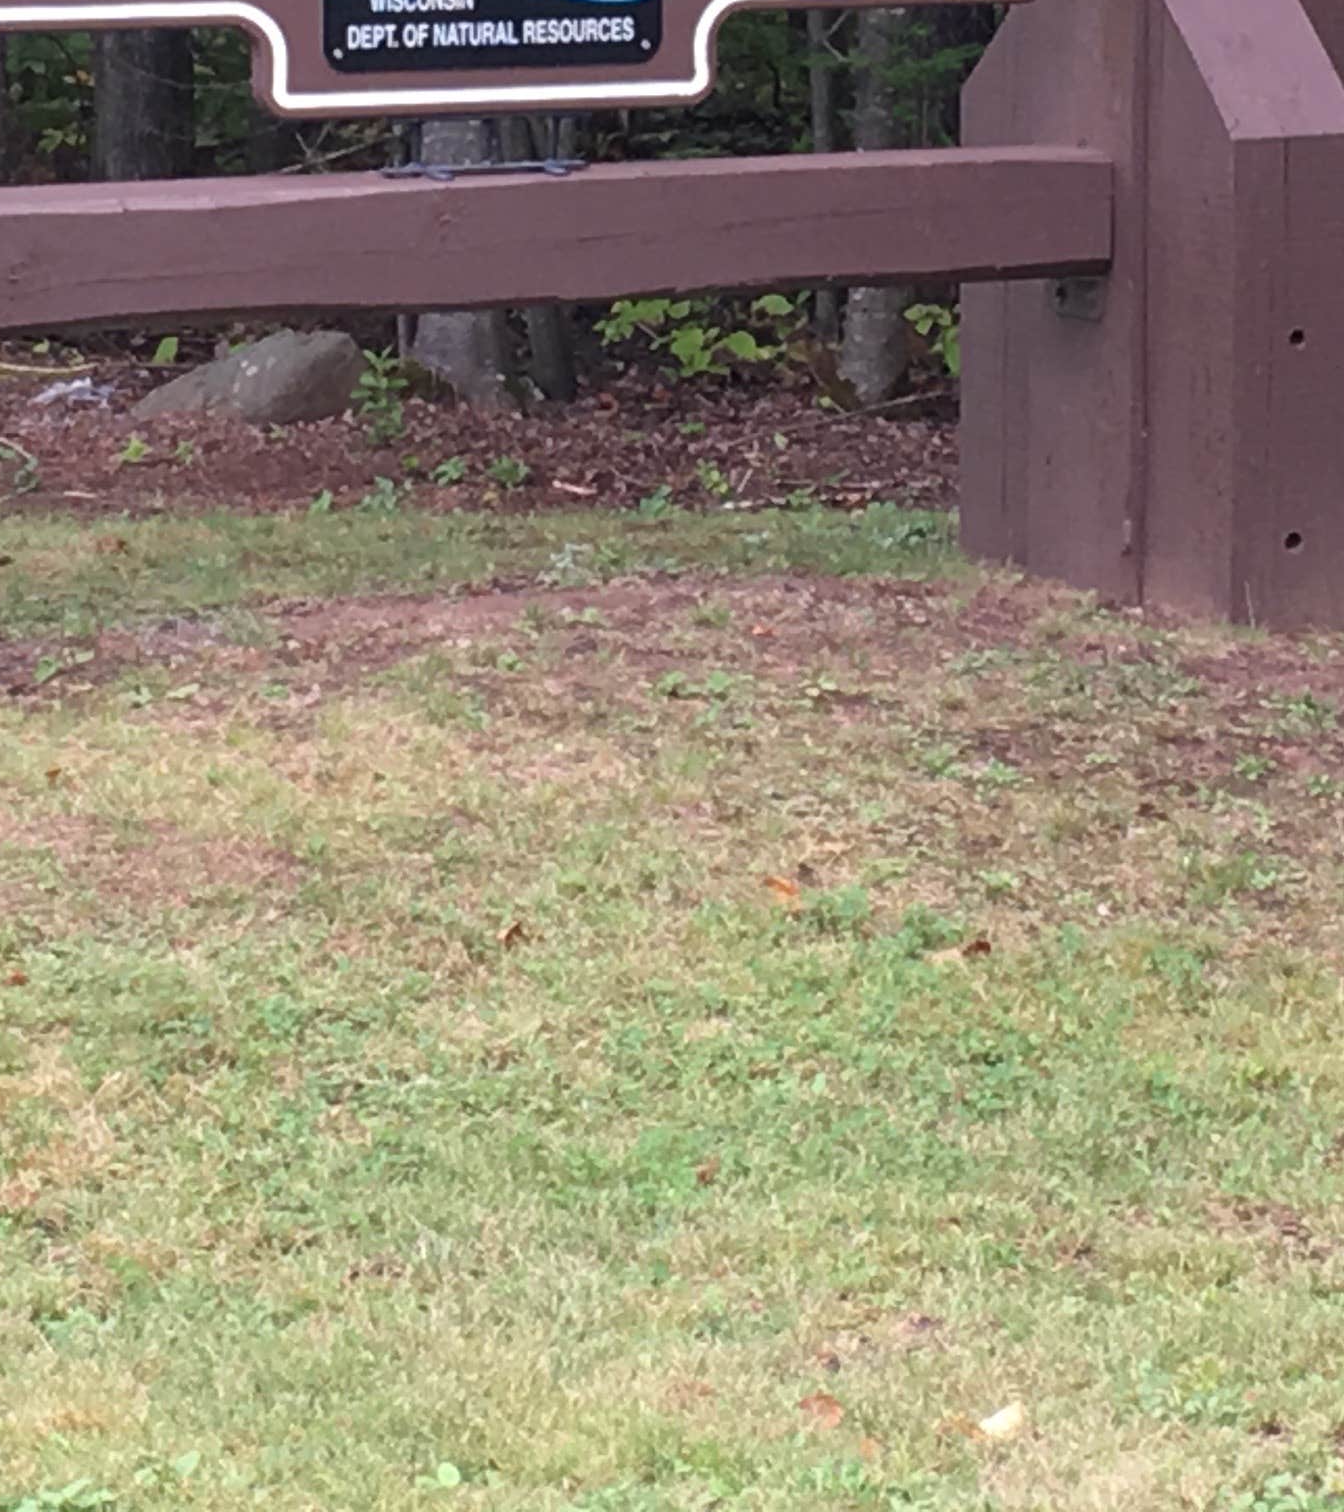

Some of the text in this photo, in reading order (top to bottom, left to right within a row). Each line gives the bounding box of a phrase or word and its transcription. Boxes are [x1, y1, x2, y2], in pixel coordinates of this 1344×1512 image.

[346, 16, 635, 50] DEPT. OF NATURAL RESOURCES
